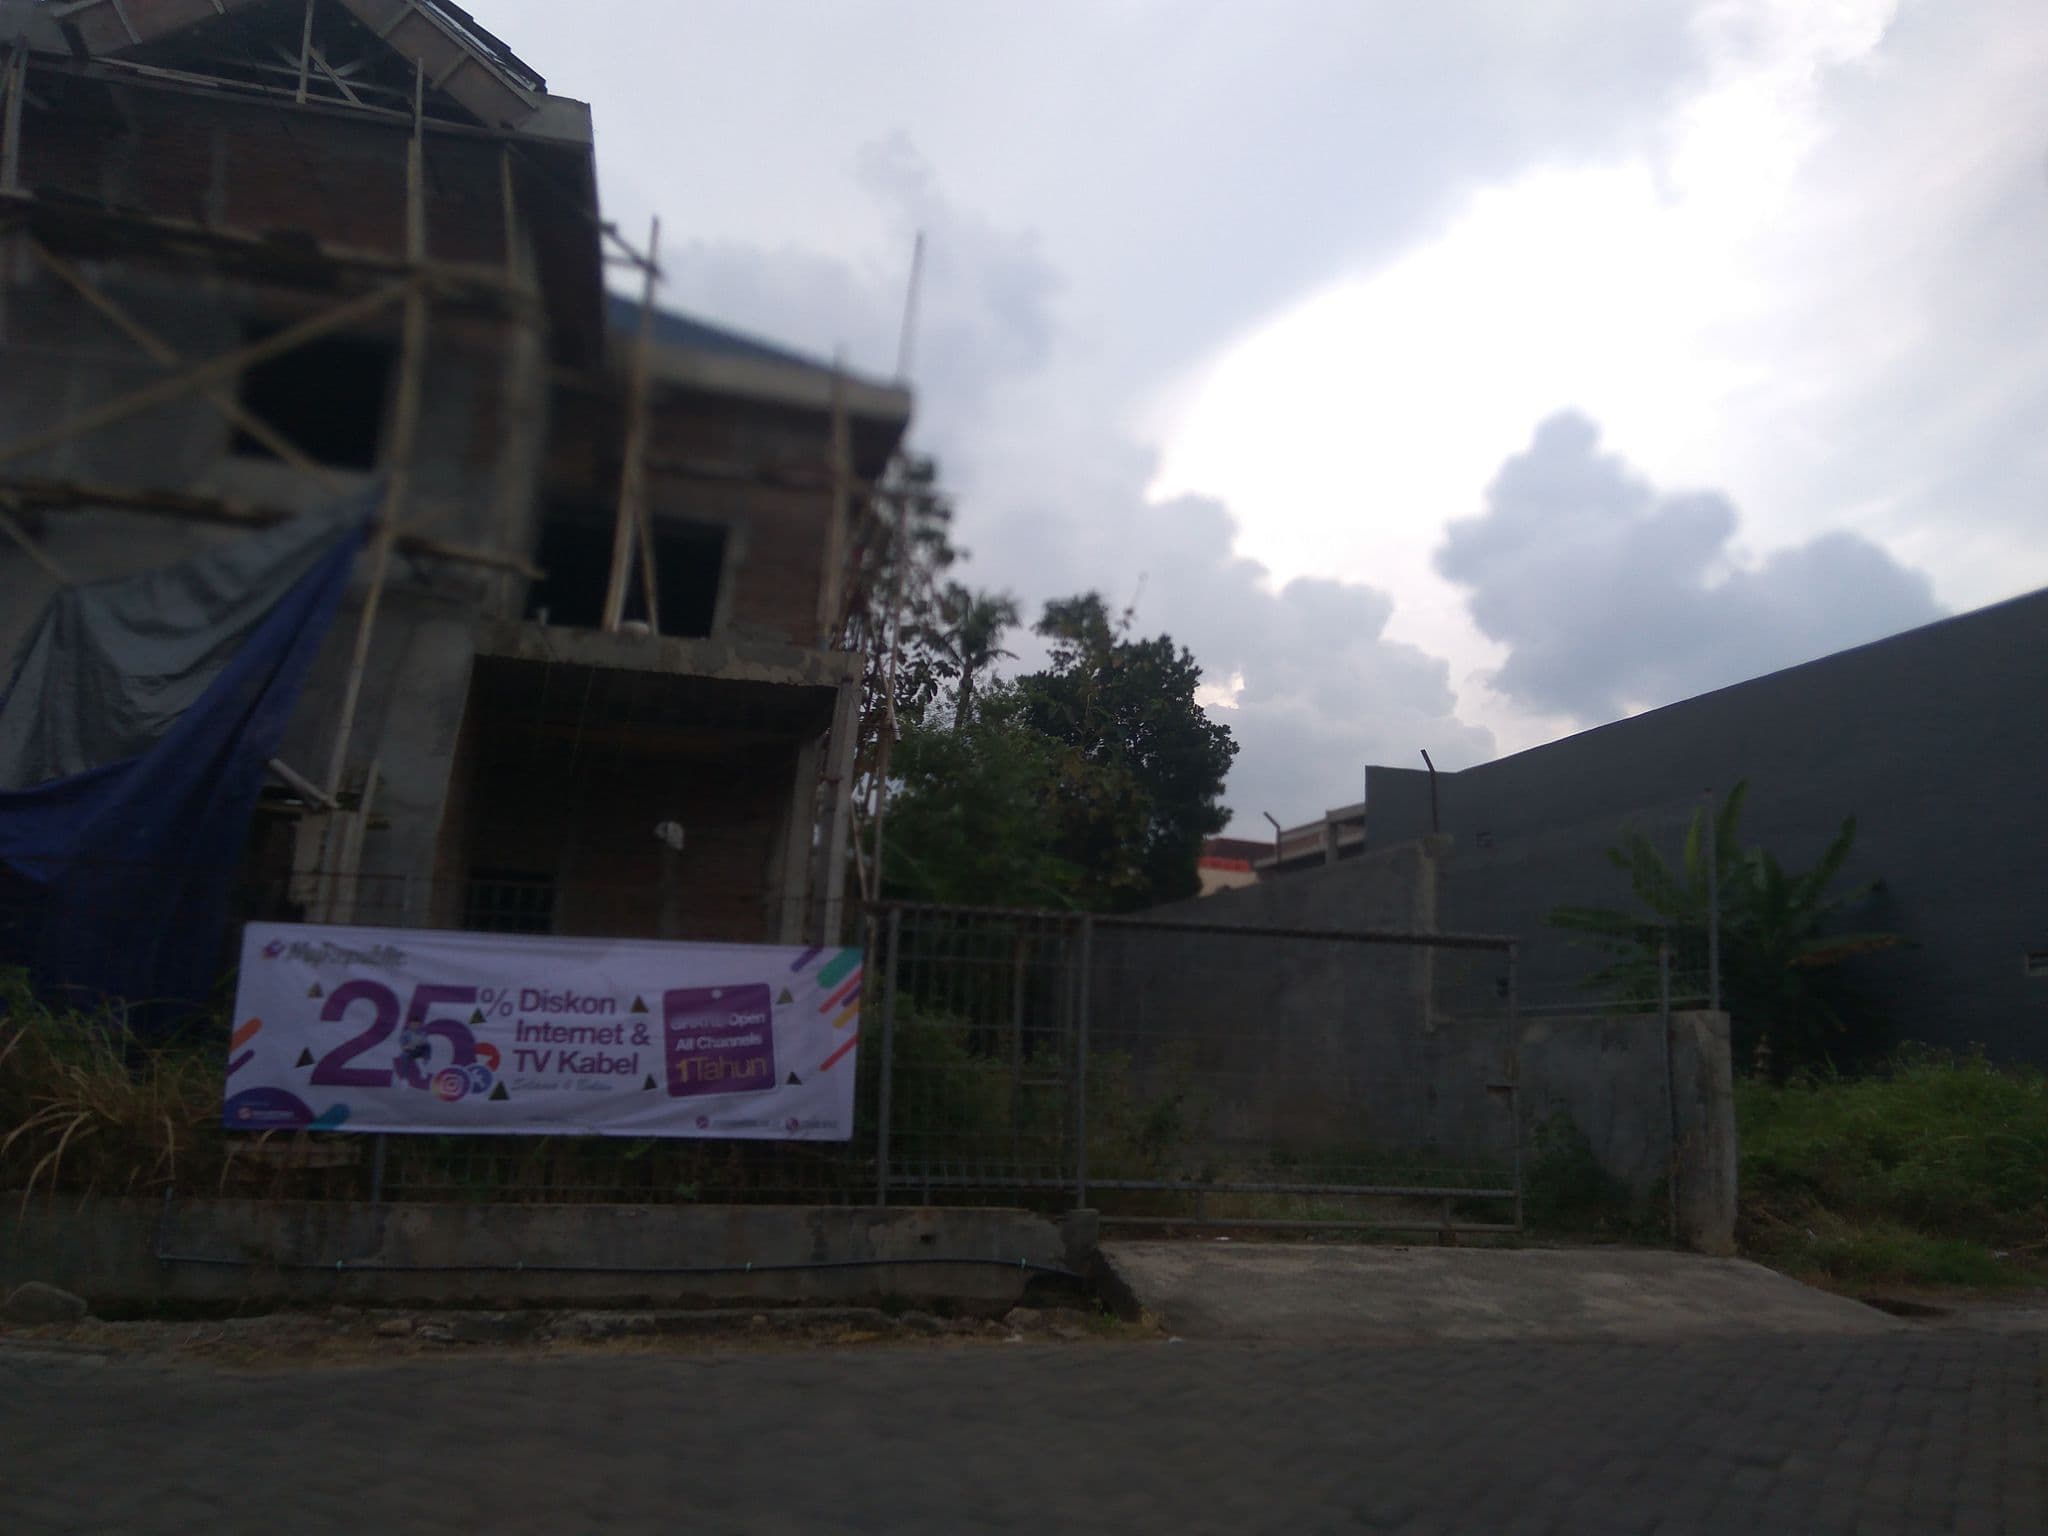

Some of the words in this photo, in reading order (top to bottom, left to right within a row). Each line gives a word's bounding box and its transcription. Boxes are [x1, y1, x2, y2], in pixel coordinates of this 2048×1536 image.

[518, 988, 617, 1015] Diskon
[514, 1019, 625, 1045] Internet
[630, 1023, 651, 1046] &
[728, 1012, 766, 1029] Open
[675, 1037, 695, 1052] All
[696, 1031, 764, 1050] Channels
[512, 1049, 553, 1073] TV
[557, 1050, 639, 1075] Kabel
[692, 1055, 769, 1081] Tahun
